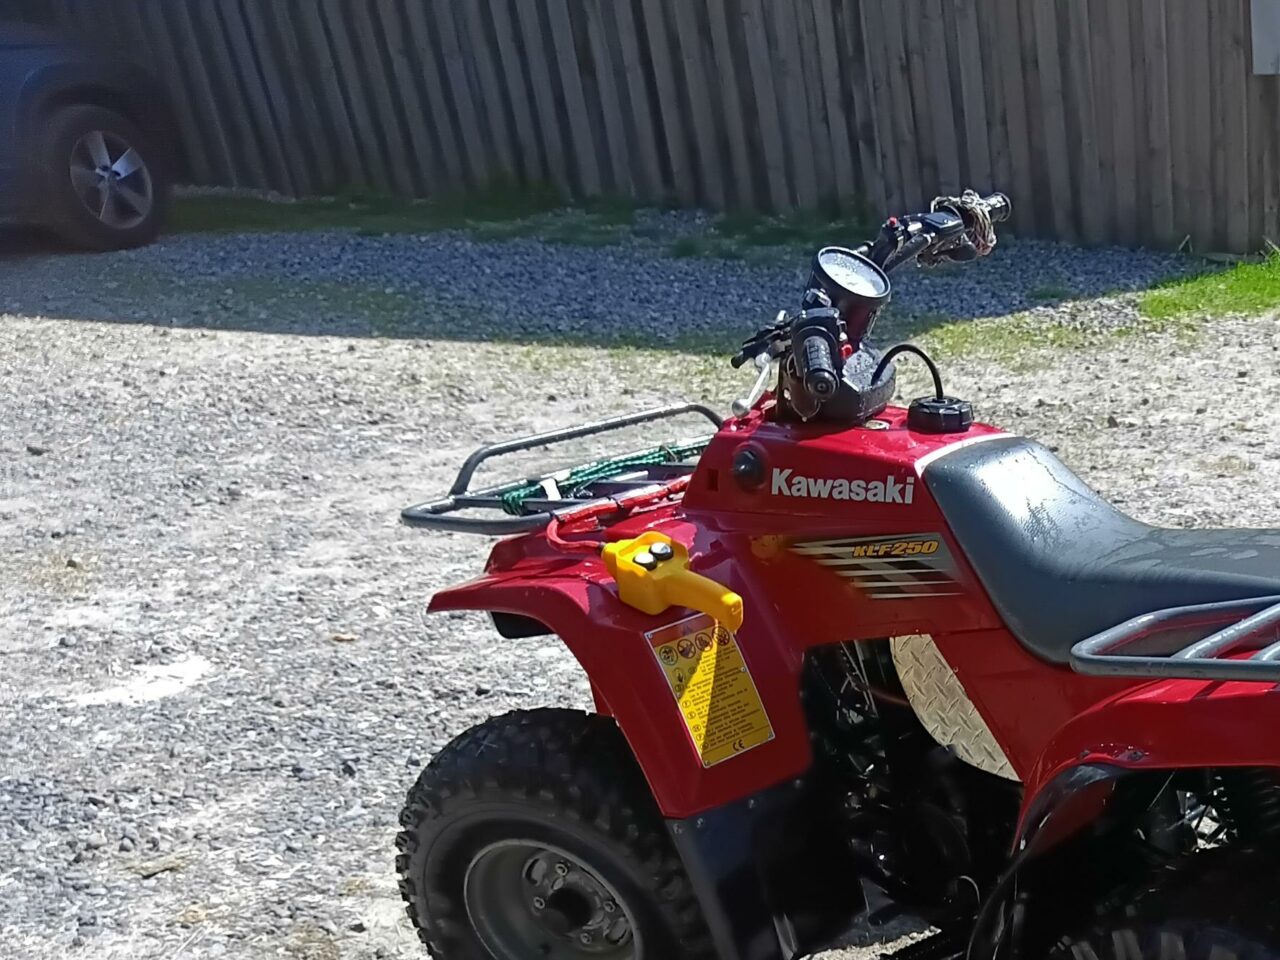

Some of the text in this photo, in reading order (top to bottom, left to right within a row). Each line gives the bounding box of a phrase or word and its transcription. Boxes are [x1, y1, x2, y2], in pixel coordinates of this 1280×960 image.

[771, 467, 915, 504] Kawasaki
[853, 540, 939, 558] KLF250
[732, 739, 745, 752] CE
